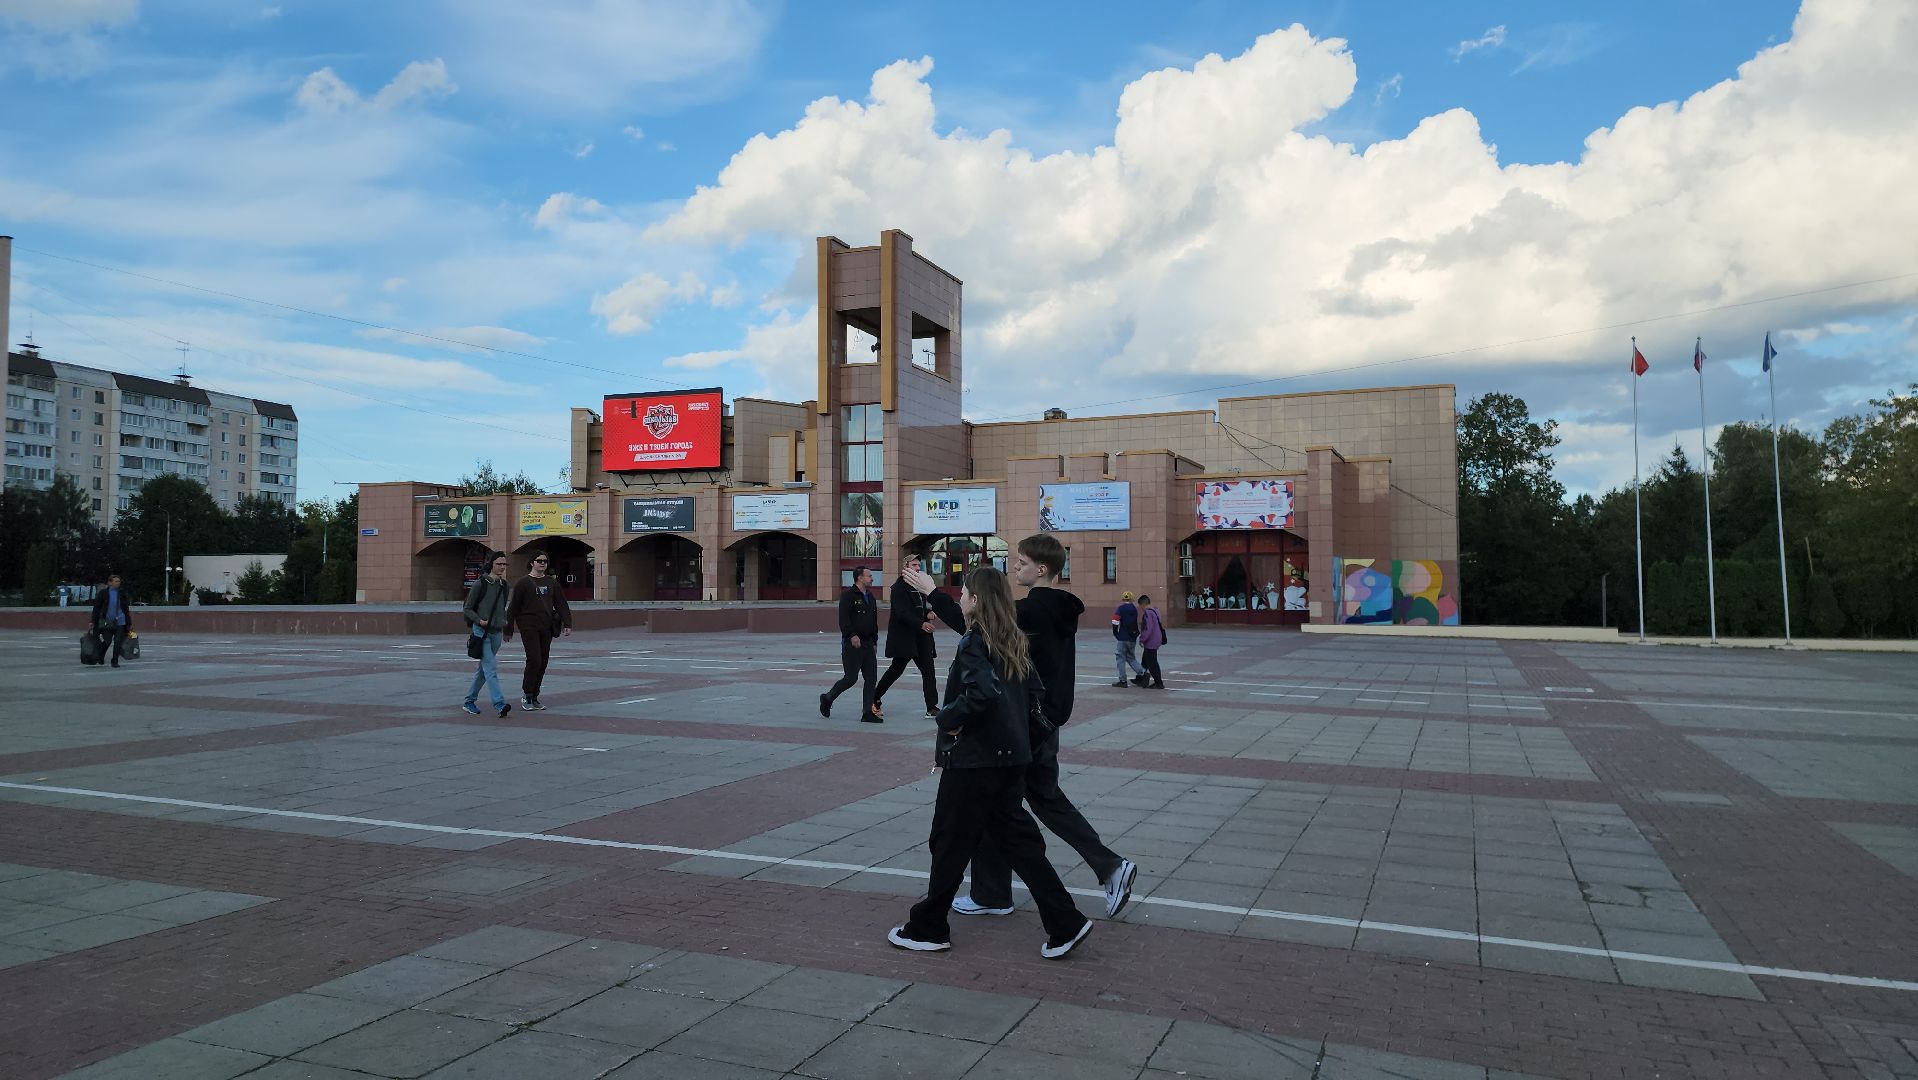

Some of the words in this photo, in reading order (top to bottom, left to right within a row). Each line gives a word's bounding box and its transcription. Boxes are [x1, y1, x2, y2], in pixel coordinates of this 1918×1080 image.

[628, 443, 643, 452] УЖЕ
[643, 443, 649, 451] В
[670, 441, 693, 450] ГОРОДЕ
